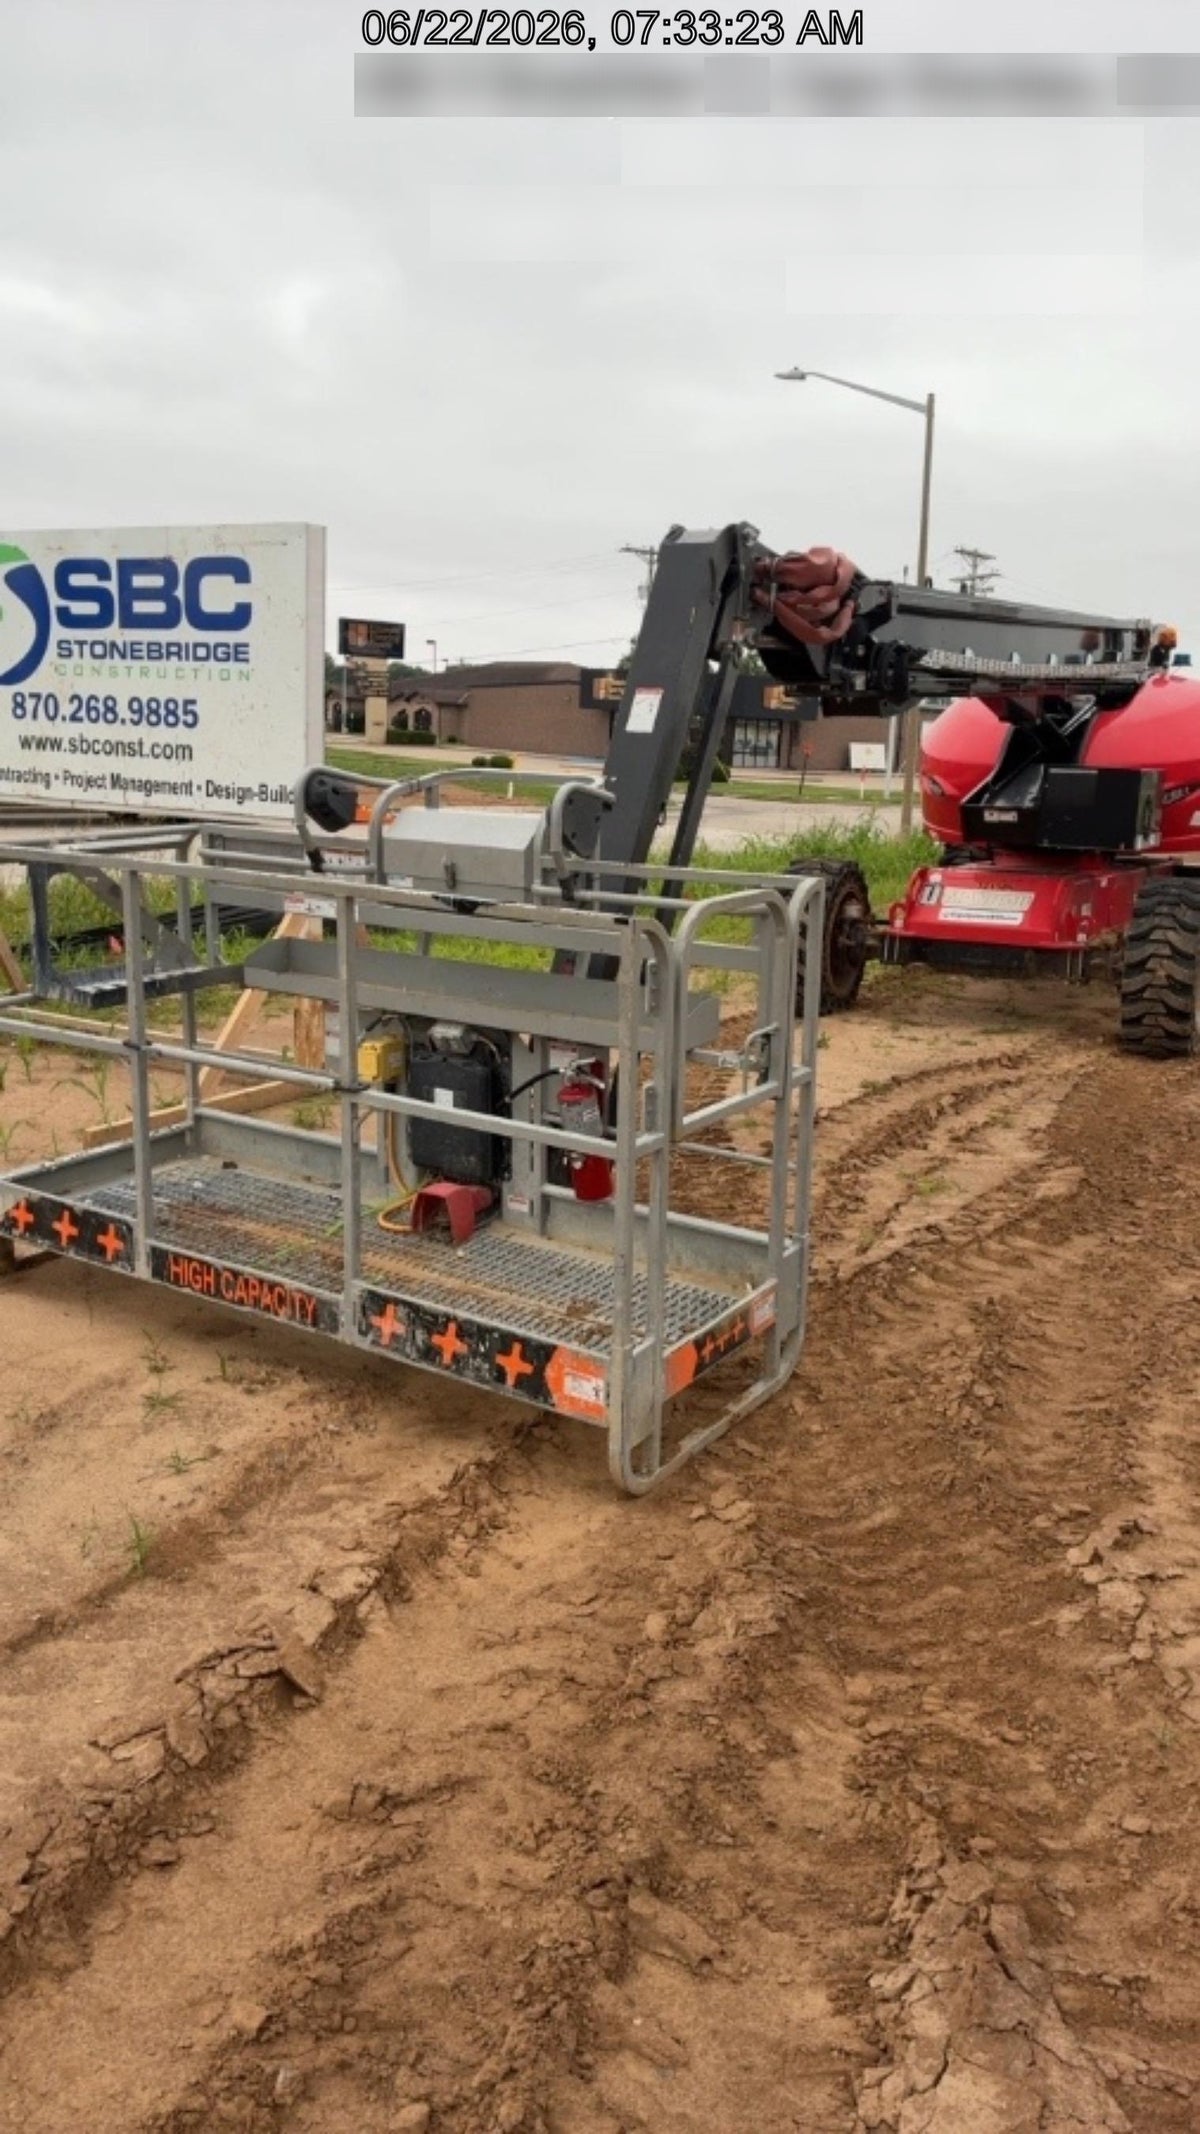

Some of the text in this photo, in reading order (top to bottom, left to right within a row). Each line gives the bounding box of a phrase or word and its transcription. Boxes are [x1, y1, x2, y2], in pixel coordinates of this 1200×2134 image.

[54, 556, 252, 632] SBC
[56, 639, 250, 663] STONEBRIDGE
[54, 664, 251, 682] CONSTRUCTION
[11, 692, 199, 729] 870.268.9885
[19, 733, 194, 761] www.sbconst.com
[63, 769, 107, 794] Project
[111, 772, 194, 797] Management
[169, 1256, 317, 1325] HIGH CAPACITY
